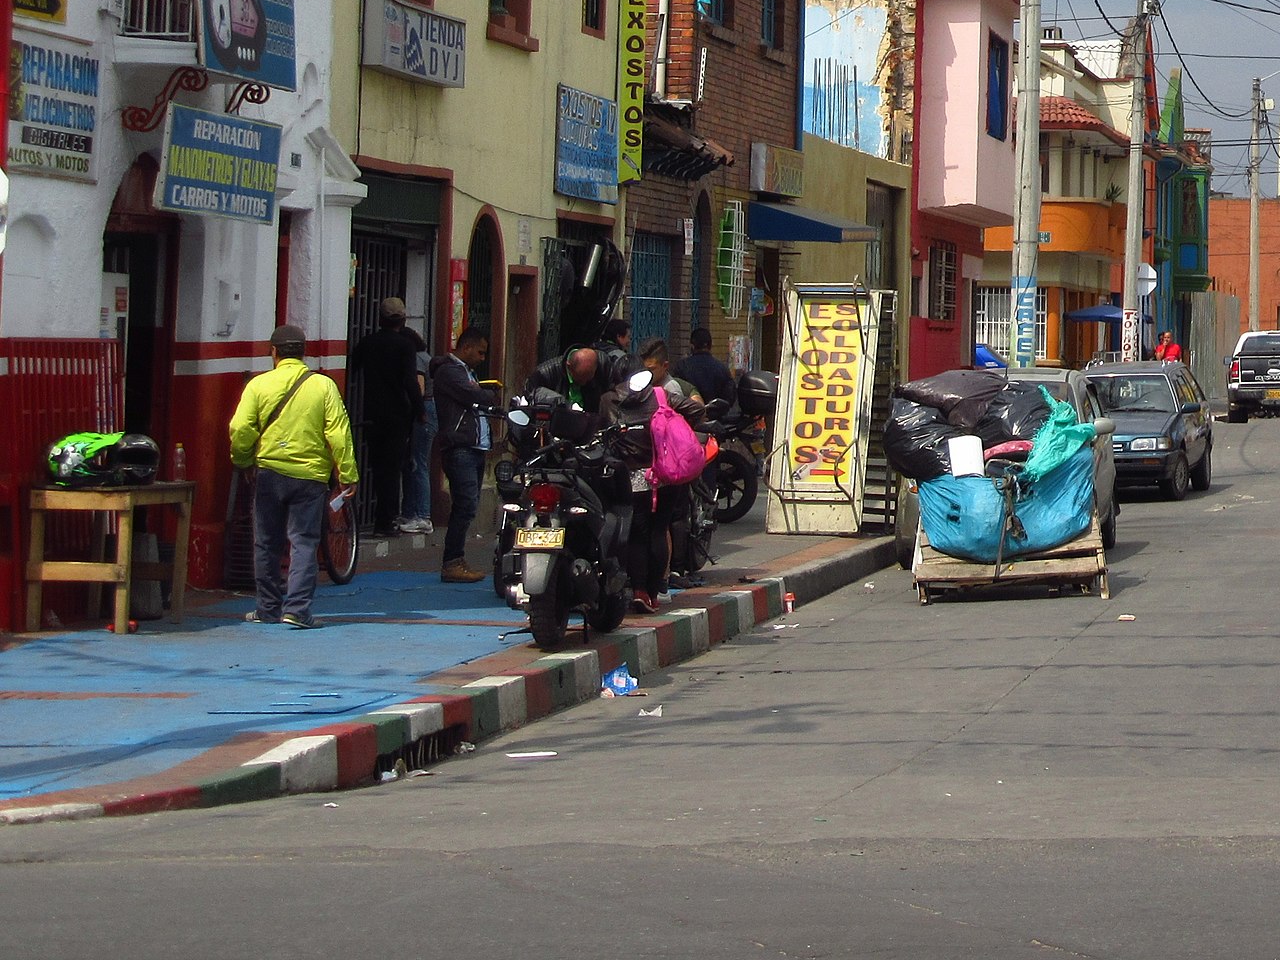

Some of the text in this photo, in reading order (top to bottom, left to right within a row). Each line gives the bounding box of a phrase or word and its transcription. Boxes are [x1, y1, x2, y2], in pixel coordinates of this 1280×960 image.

[417, 12, 464, 51] TIENDA
[22, 43, 100, 97] REPARACIÓN
[30, 128, 87, 152] DIGITALES
[193, 119, 262, 151] REPARACIÓN
[8, 147, 90, 173] AUTOS Y MOTOS
[168, 144, 234, 185] MANOMETROS
[233, 155, 241, 186] Y
[241, 158, 277, 193] GUAYAS
[172, 184, 268, 217] CARROS Y MOTOS
[794, 302, 832, 464] EXOSTOS
[822, 302, 860, 464] SOLDADURAS
